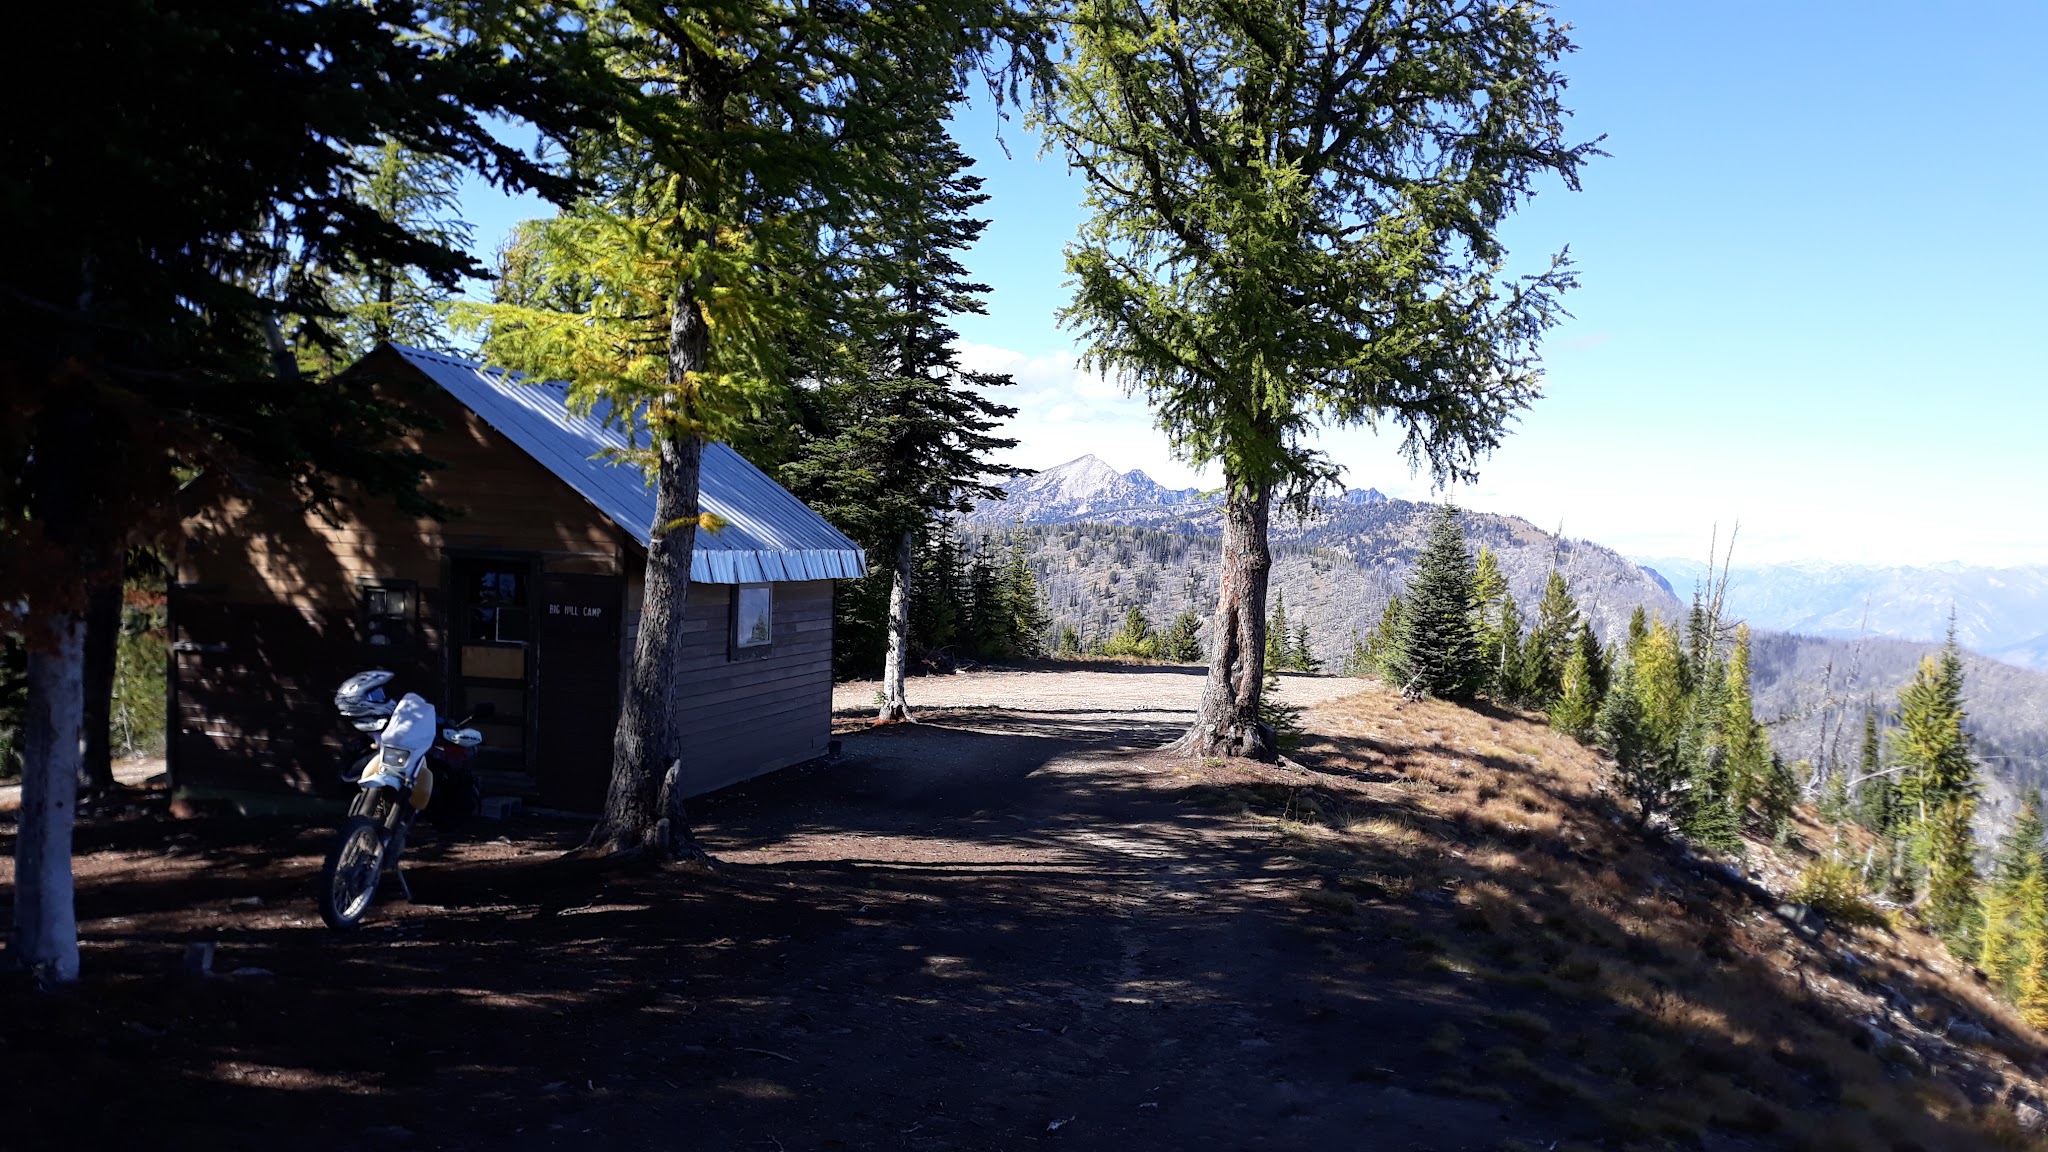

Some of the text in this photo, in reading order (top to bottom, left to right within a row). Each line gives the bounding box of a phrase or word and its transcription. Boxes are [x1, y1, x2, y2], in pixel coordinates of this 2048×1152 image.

[549, 603, 602, 618] BIG HILL CAMP
